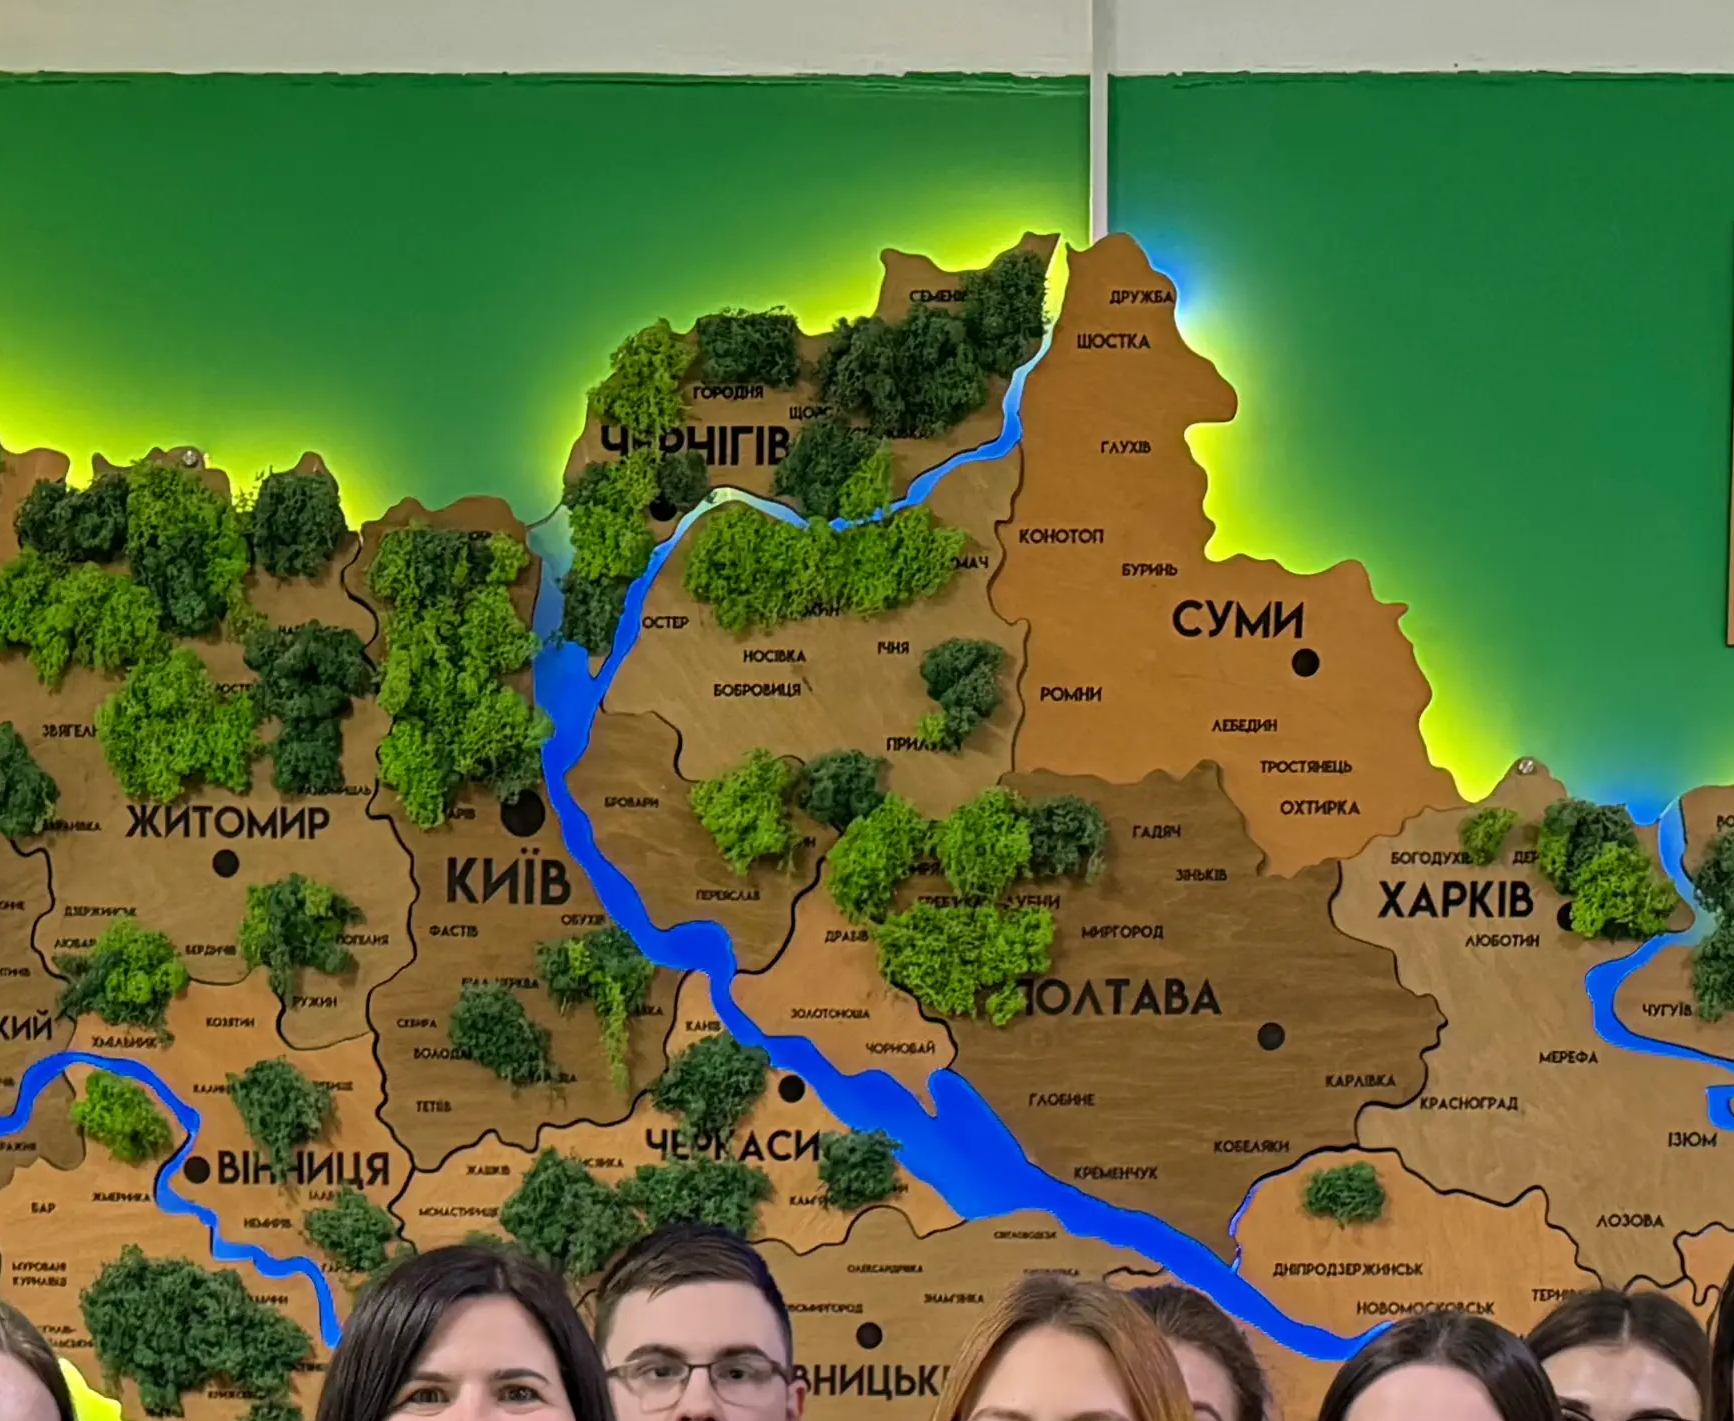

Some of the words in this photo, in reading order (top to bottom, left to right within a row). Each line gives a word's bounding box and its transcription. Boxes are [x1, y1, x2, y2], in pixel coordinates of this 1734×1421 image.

[1109, 290, 1175, 305] ДРУЖБА
[1077, 333, 1151, 350] ШОСТКА
[693, 386, 763, 400] ГОРОДНЯ
[1101, 440, 1151, 454] ГЛУХІВ
[1019, 528, 1104, 544] КОНОТОП
[1122, 563, 1178, 577] БУРИНЬ
[639, 616, 689, 630] ОСТЕР
[1172, 599, 1305, 639] СУМИ
[877, 641, 910, 655] ІЧНЯ
[744, 650, 807, 664] НОСІВКА
[714, 683, 801, 698] БОБРОВИЦЯ
[1040, 687, 1102, 702] РОМНИ
[1212, 719, 1278, 733] ЛЕБЕДИН
[1260, 760, 1353, 774] ТРОСТЯНЕЦЬ
[1280, 800, 1361, 816] ОХТИРКА
[125, 805, 330, 839] ЖИТОМИР
[1132, 825, 1182, 840] ГАДЯЧ
[446, 848, 571, 905] КИЇВ
[1176, 869, 1228, 882] ЗІНЬКІВ
[1377, 881, 1534, 918] ХАРКІВ
[1082, 925, 1164, 940] МИРГОРОД
[1465, 934, 1540, 948] ЛЮБОТИН
[791, 1008, 870, 1019] ЗОЛОТОНОША
[866, 1040, 936, 1054] ЧОРНОБАЙ
[1539, 1051, 1599, 1064] МЕРЕФА
[1326, 1075, 1396, 1088] КАРЛІВКА
[1029, 1093, 1096, 1107] ГЛОБИНЕ
[1420, 1097, 1519, 1111] КРАСНОГРАД
[1214, 1140, 1290, 1154] КОБЕЛЯКИ
[1668, 1132, 1718, 1148] ІЗЮМ
[1074, 1166, 1158, 1180] КРЕМЕНЧУК
[31, 1203, 56, 1214] БАР
[1596, 1214, 1665, 1228] ЛОЗОВА
